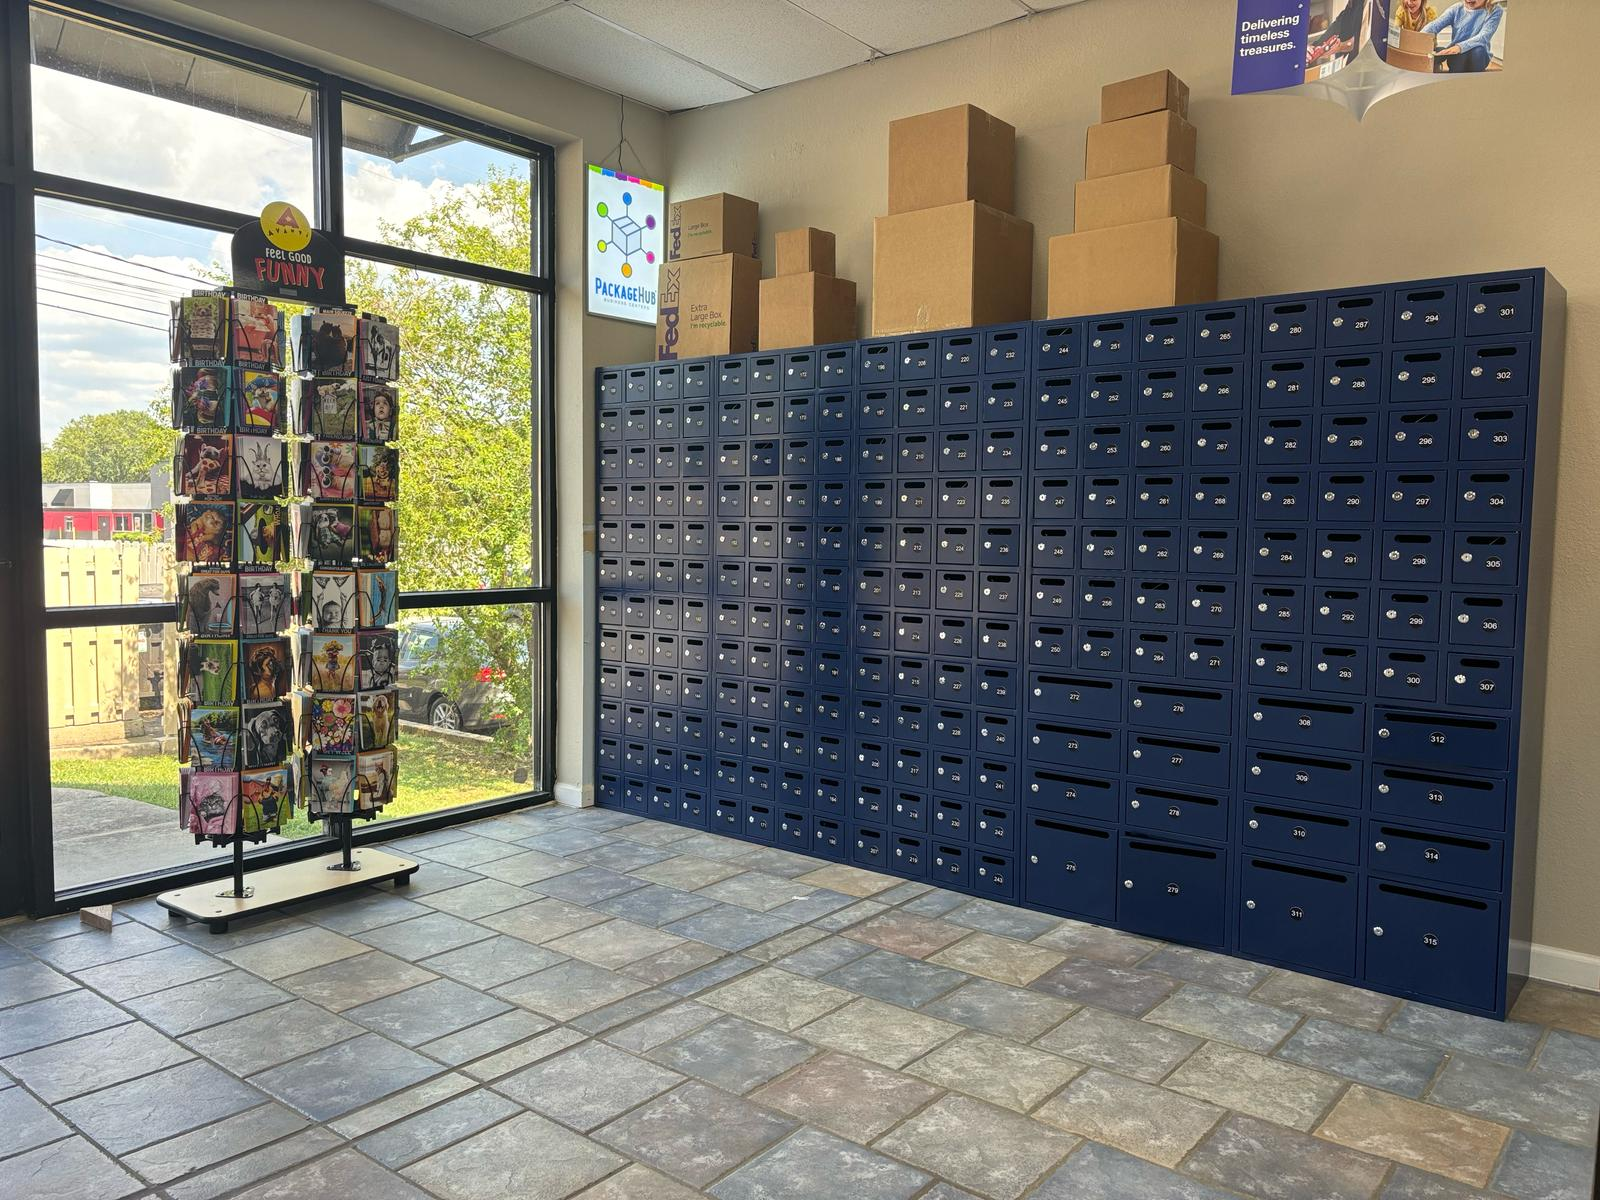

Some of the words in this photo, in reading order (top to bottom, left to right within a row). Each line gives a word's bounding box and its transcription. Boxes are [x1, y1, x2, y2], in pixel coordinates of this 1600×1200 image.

[1242, 15, 1300, 32] Delivering
[1240, 30, 1290, 44] timeless
[1240, 41, 1296, 56] treasures.
[670, 204, 682, 260] FedEx
[288, 252, 312, 264] GOOD
[255, 256, 325, 290] FUNNY
[194, 290, 226, 298] BIRTHDAY
[237, 292, 266, 303] BIRTHDAY
[690, 304, 708, 312] Extra
[1499, 308, 1515, 316] 301
[658, 266, 680, 360] FedEx
[690, 313, 708, 324] Large
[709, 311, 722, 320] Box
[239, 361, 265, 369] BIRTHDAY
[1496, 371, 1511, 379] 302
[1493, 435, 1508, 443] 303
[1489, 497, 1504, 506] 304
[1486, 560, 1501, 568] 305
[1482, 622, 1498, 630] 306
[1479, 683, 1495, 691] 307
[1069, 692, 1080, 700] 272
[1298, 718, 1311, 727] 308
[1430, 735, 1445, 744] 312
[1067, 741, 1078, 750] 273
[1296, 773, 1308, 783] 309
[1065, 790, 1076, 798] 274
[1428, 793, 1443, 802] 313
[1293, 828, 1306, 838] 310
[1424, 851, 1439, 860] 314
[1066, 863, 1077, 872] 275
[1290, 909, 1303, 918] 311
[1423, 937, 1438, 946] 315
